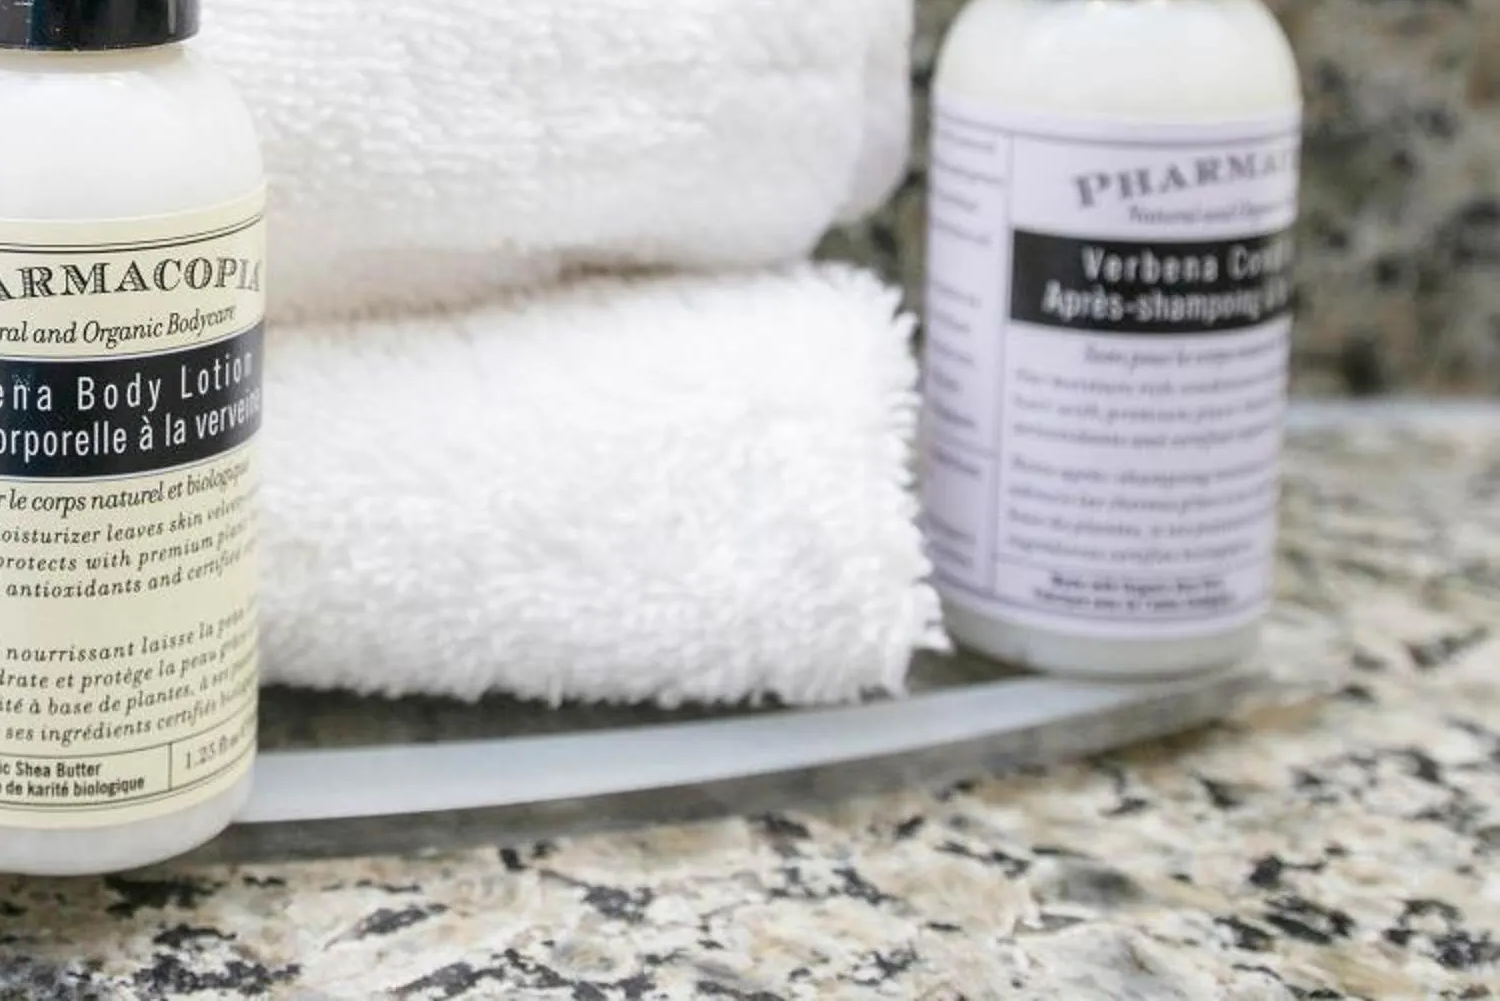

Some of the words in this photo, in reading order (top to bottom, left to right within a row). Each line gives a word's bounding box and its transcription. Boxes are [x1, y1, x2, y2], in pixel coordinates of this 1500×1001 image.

[1080, 246, 1219, 285] Verbena
[33, 320, 77, 344] and
[82, 321, 164, 349] Organic
[77, 371, 162, 412] Body
[180, 350, 253, 399] Lotion
[138, 419, 155, 452] à
[165, 412, 187, 448] la
[9, 488, 28, 511] le
[30, 494, 87, 519] corps
[91, 480, 164, 511] naturel
[167, 480, 184, 499] et
[106, 522, 165, 543] leaves
[169, 510, 204, 533] skin
[85, 548, 132, 570] with
[137, 534, 214, 572] premium
[5, 578, 142, 599] antioxidants
[147, 566, 183, 591] and
[5, 640, 135, 663] nourrissant
[141, 630, 195, 655] laisse
[55, 672, 75, 690] et
[79, 665, 154, 694] protège
[158, 658, 176, 679] la
[28, 697, 41, 716] à
[47, 696, 94, 716] base
[98, 693, 127, 714] de
[4, 725, 34, 741] ses
[40, 717, 152, 748] ingrédients
[14, 759, 51, 778] Shea
[55, 761, 102, 779] Butter
[5, 778, 24, 797] de
[26, 778, 70, 799] karité
[72, 775, 145, 798] biologique
